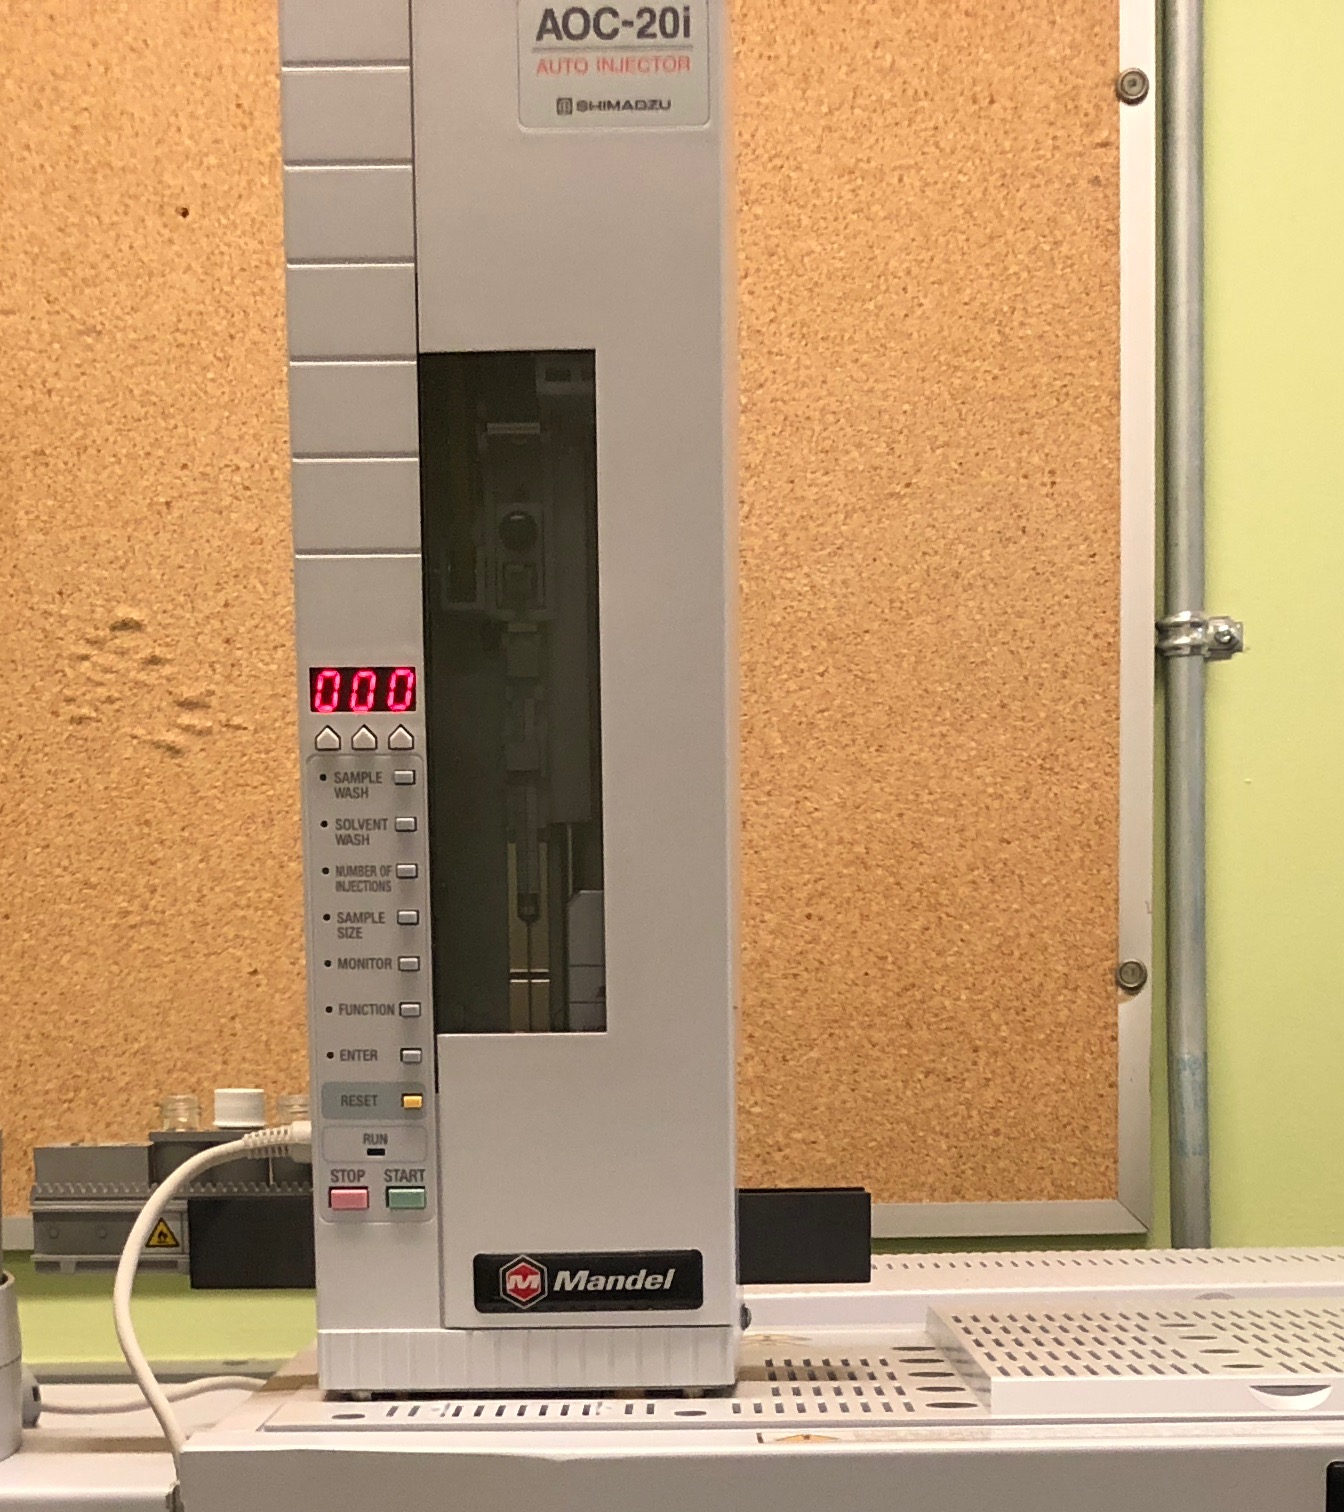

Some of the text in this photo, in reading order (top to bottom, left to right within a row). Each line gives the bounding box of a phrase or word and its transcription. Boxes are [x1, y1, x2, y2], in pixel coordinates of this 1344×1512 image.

[535, 6, 691, 41] AOC-20i
[536, 55, 690, 76] AUTO INJECTOR
[576, 99, 672, 113] SHIMADZU
[314, 669, 414, 713] 000
[334, 771, 382, 784] SAMPLE
[334, 787, 369, 799] WASH
[335, 818, 388, 831] SOLVENT
[335, 834, 370, 847] WASH
[336, 864, 393, 877] NUMBER OF
[336, 879, 392, 893] INJECTIONS
[337, 911, 385, 924] SAMPLE
[337, 927, 363, 940] SIZE
[337, 957, 392, 971] MONITOR
[338, 1003, 395, 1016] FUNCTION
[340, 1048, 378, 1061] ENTER
[340, 1094, 378, 1107] RESET
[362, 1132, 388, 1145] RUN
[330, 1168, 366, 1183] STOP
[384, 1168, 426, 1183] START
[553, 1268, 676, 1291] Mandel
